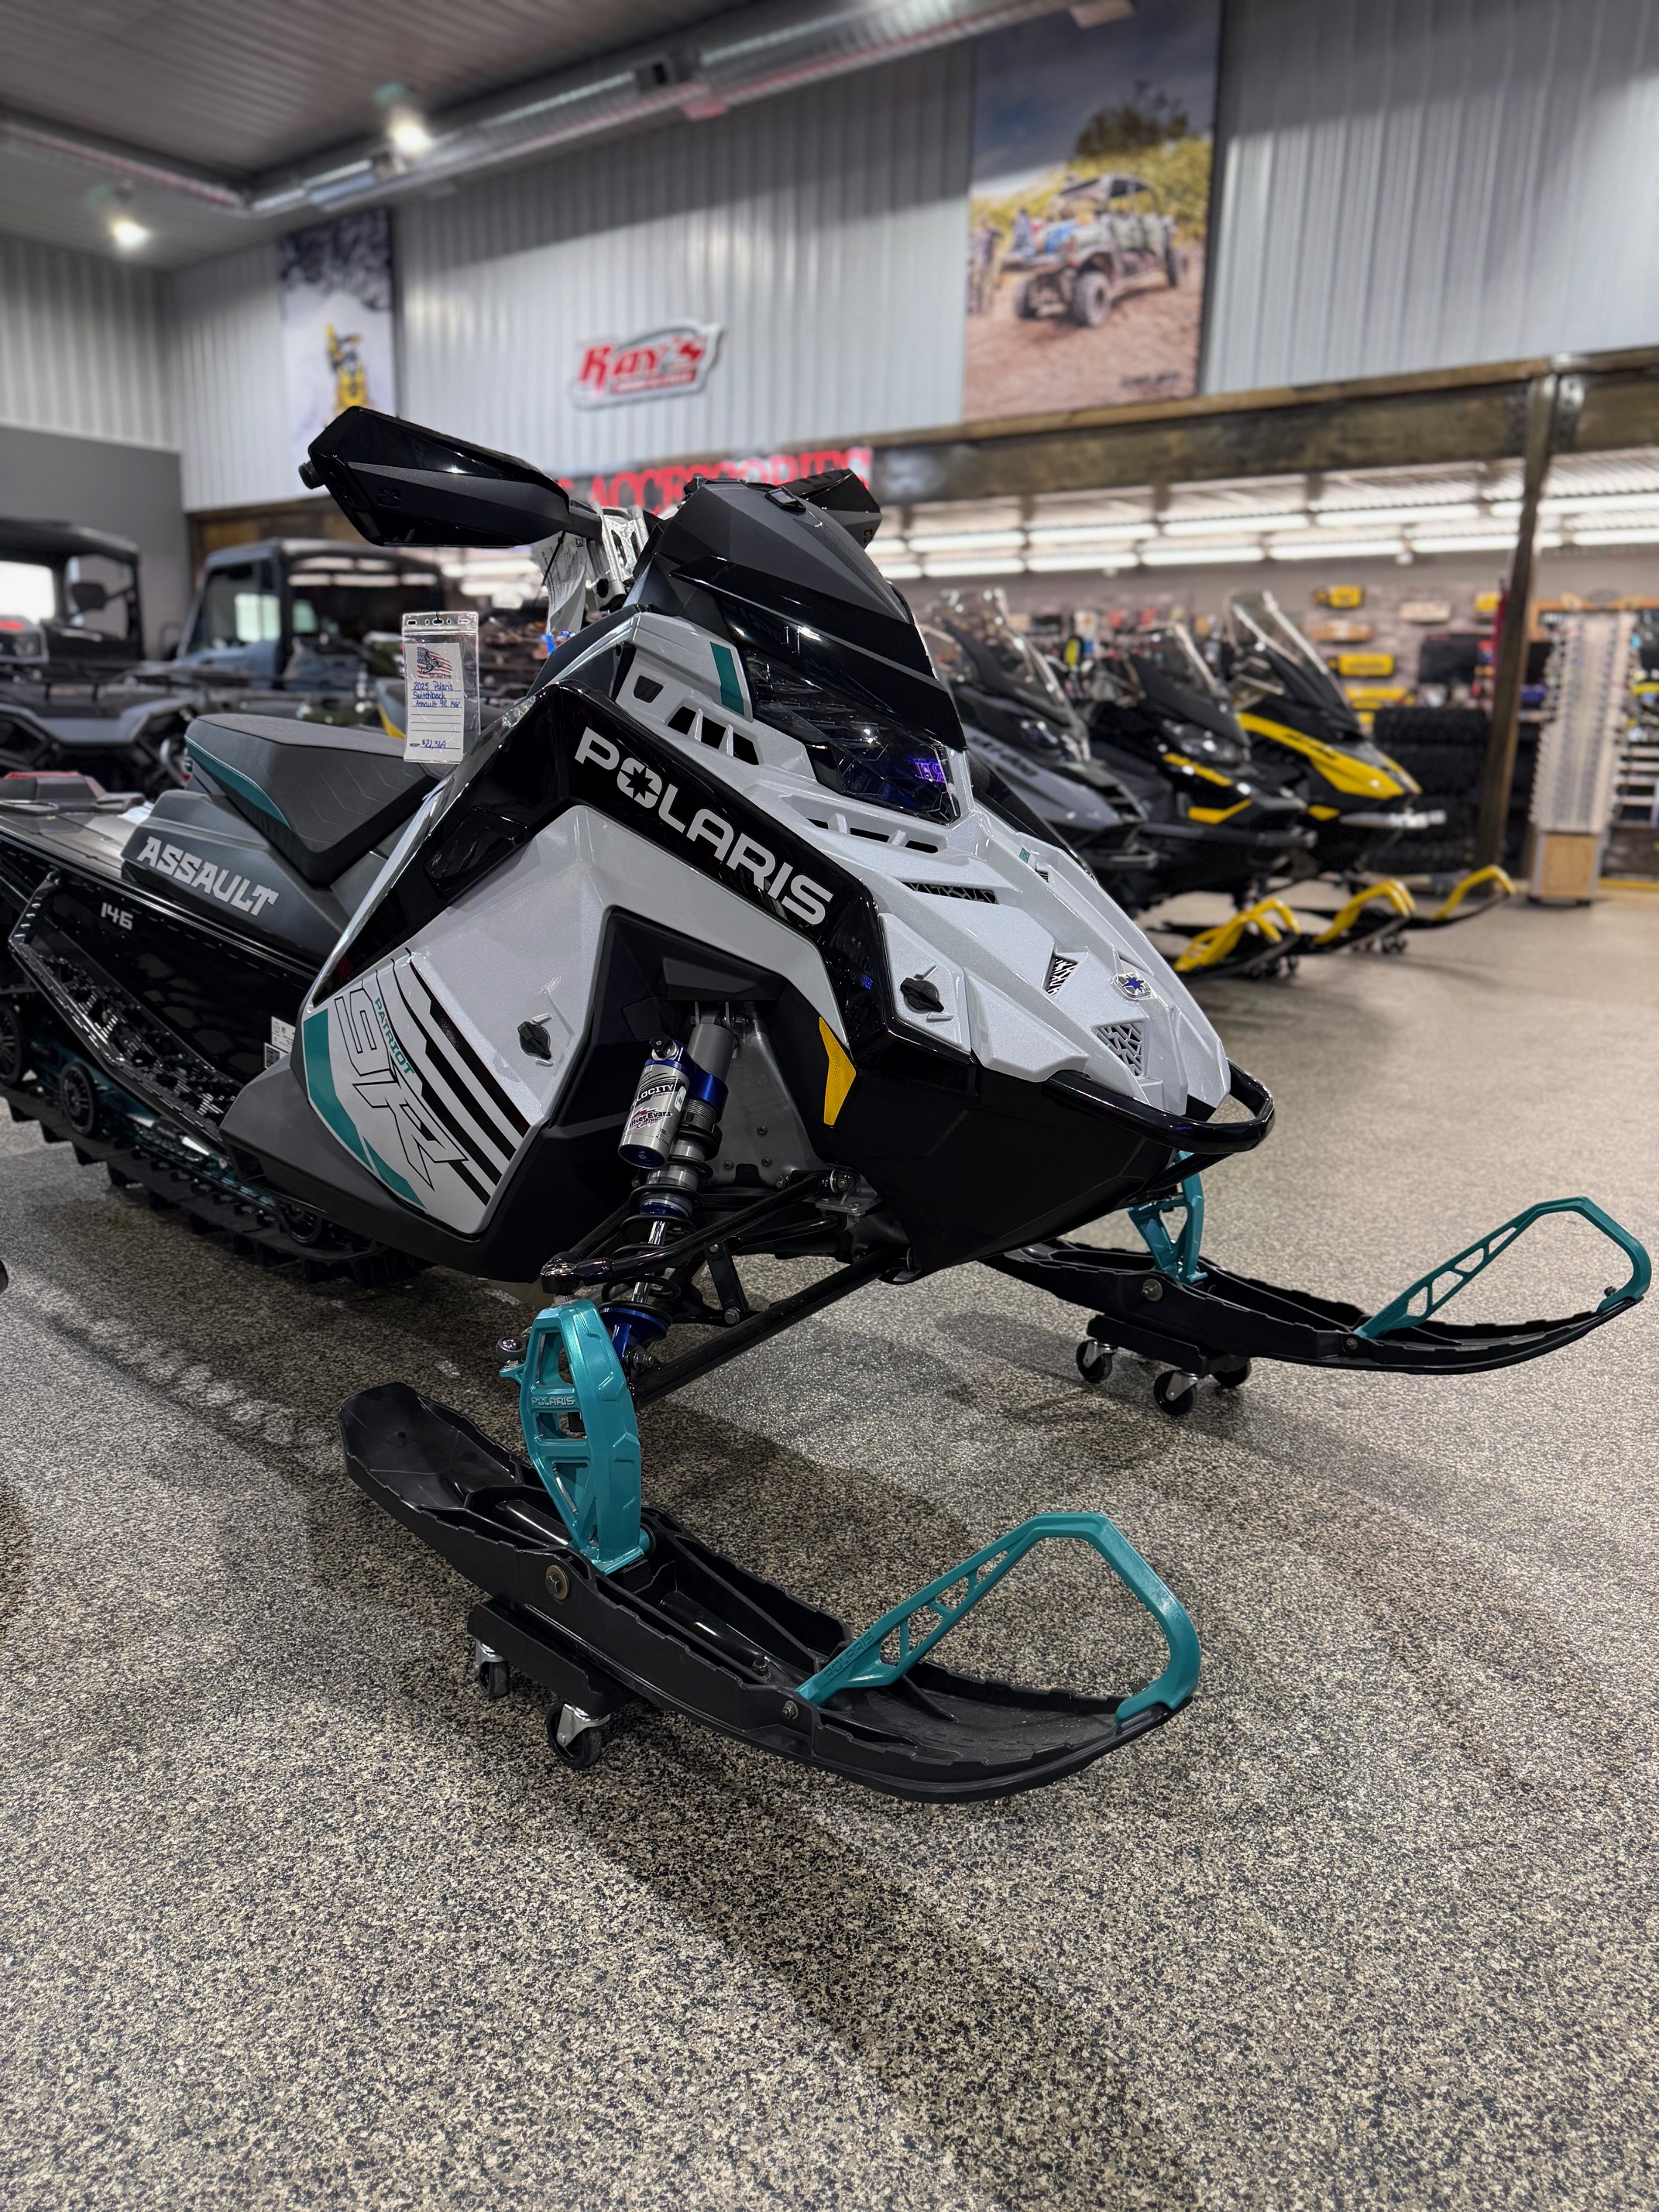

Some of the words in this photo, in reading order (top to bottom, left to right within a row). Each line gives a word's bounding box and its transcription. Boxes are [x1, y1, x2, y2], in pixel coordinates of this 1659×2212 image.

[413, 682, 429, 691] 2025
[433, 680, 454, 691] Polaris
[413, 691, 447, 699] Switchback
[415, 699, 437, 708] Assault
[574, 726, 833, 926] POLARIS
[136, 836, 280, 916] ASSAULT
[101, 902, 133, 930] 146
[375, 998, 415, 1074] PATRIOT
[632, 1084, 674, 1106] LOCITY
[531, 1396, 575, 1406] POLARIS
[823, 1632, 874, 1679] POLARIS
